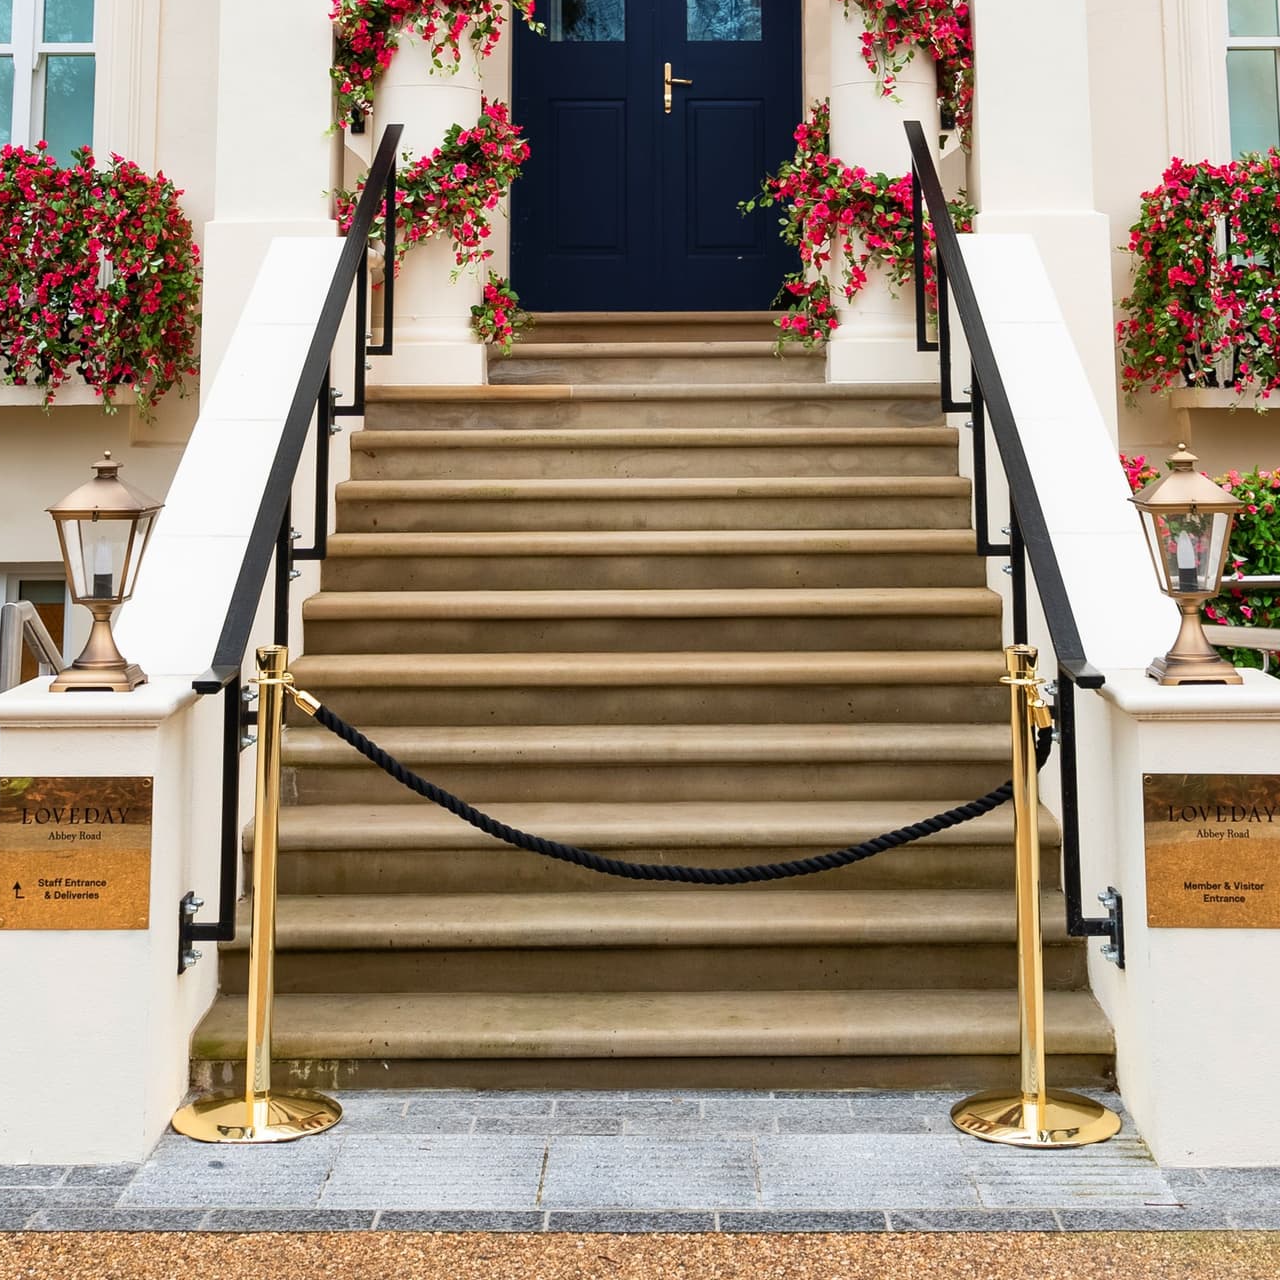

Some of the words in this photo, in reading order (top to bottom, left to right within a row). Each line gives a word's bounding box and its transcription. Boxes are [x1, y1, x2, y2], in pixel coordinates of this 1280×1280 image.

[21, 807, 130, 825] LOVEDAY
[1167, 805, 1277, 823] LOVEDAY
[48, 831, 77, 843] Abbey
[79, 831, 102, 841] Road
[1196, 829, 1225, 840] Abbey
[1227, 829, 1250, 839] Road
[38, 878, 62, 888] Staff
[64, 878, 108, 888] Entrance
[1183, 881, 1222, 891] Member
[1223, 882, 1231, 891] &
[1233, 881, 1264, 891] Visitor
[44, 891, 51, 900] &
[54, 890, 100, 900] Deliveries
[1203, 893, 1246, 903] Entrance
